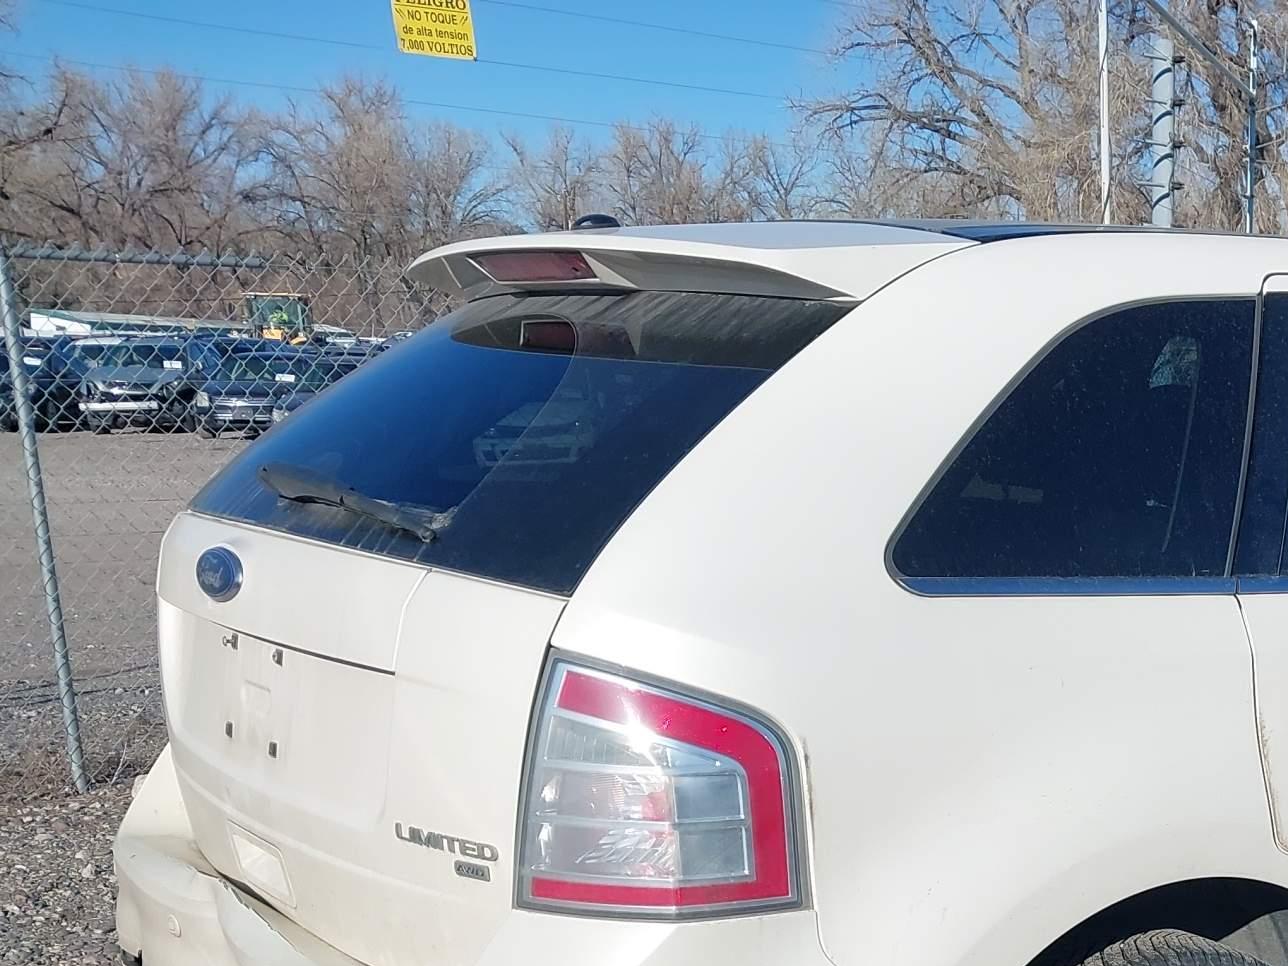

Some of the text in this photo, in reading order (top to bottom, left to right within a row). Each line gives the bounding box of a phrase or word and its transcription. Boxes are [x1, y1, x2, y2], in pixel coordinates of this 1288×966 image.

[407, 10, 458, 25] NO TOQUE
[402, 24, 469, 41] de alta tension
[400, 38, 474, 56] 7,000 VOLTIOS
[395, 822, 499, 862] LIMITED
[455, 862, 488, 879] AWD
